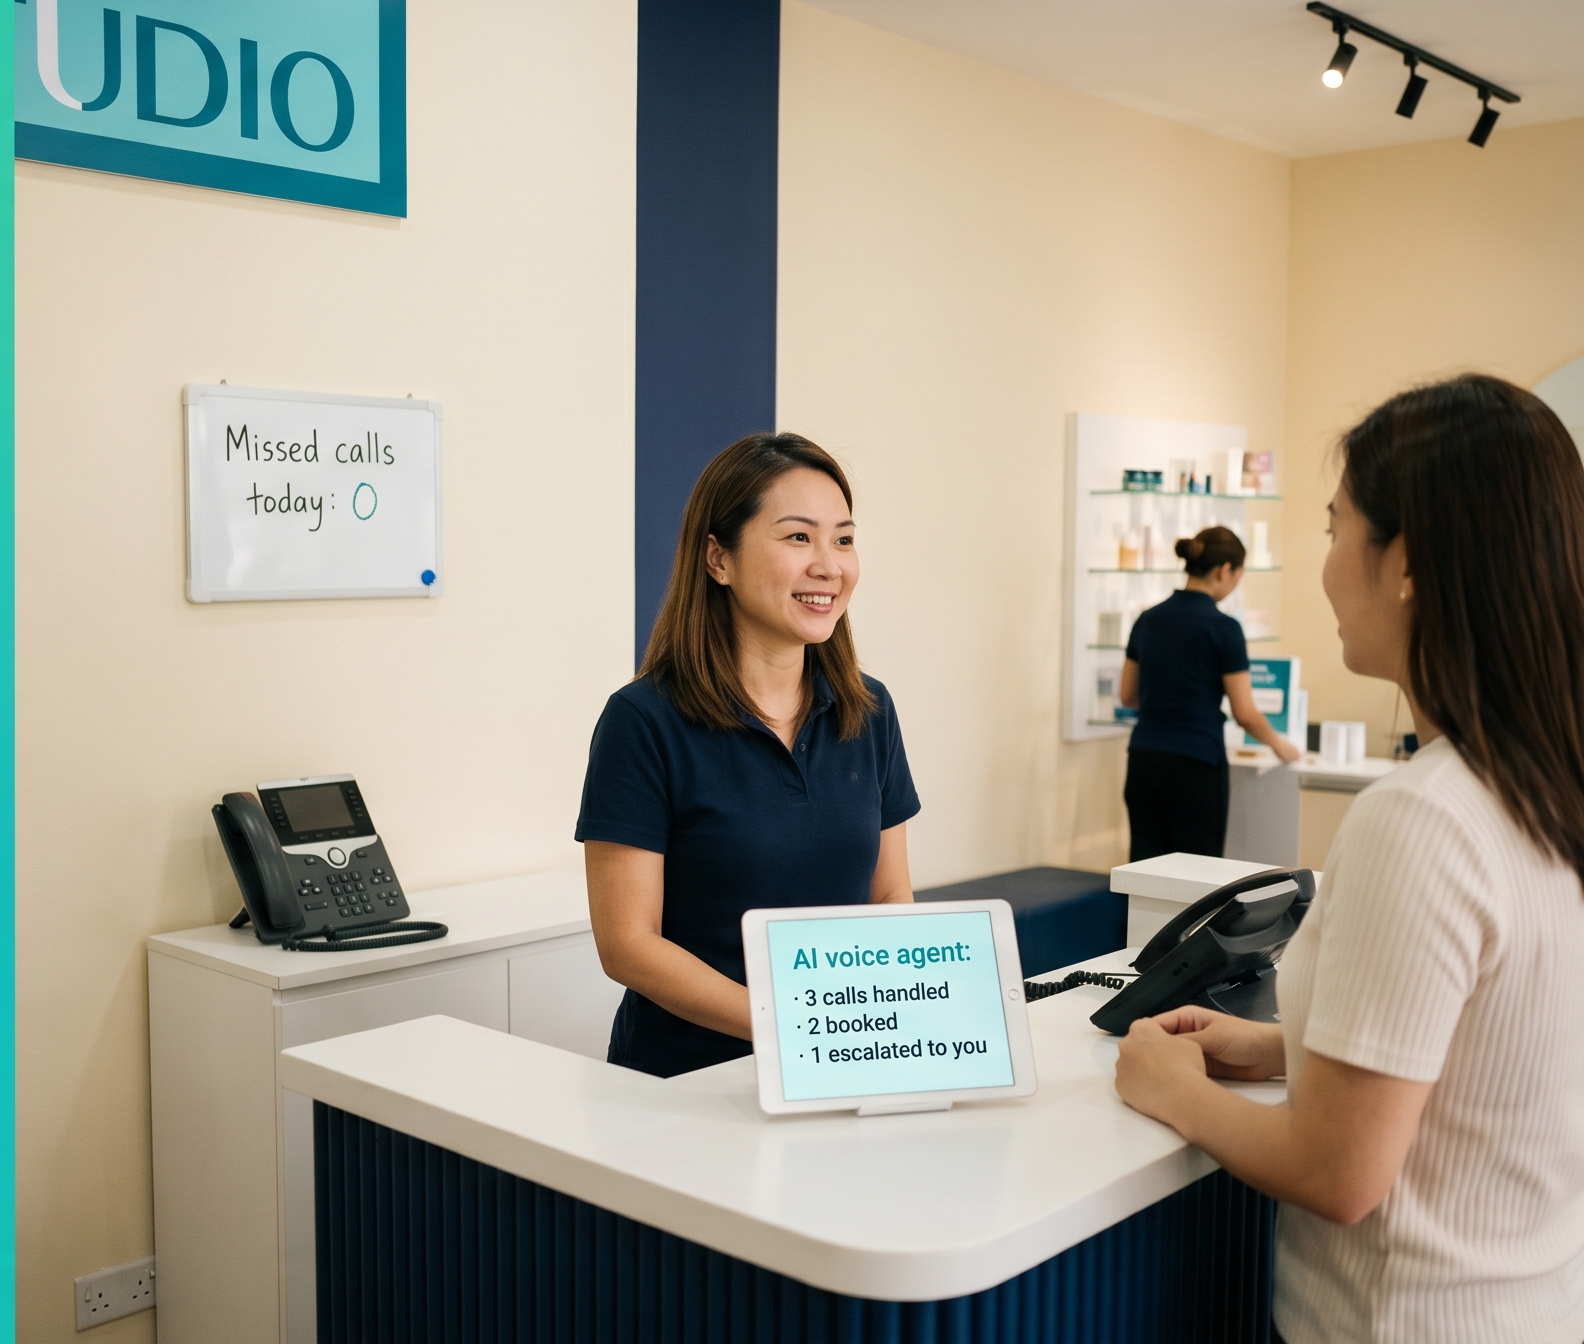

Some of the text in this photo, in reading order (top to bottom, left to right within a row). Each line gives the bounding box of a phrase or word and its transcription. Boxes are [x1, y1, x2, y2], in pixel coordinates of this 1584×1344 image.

[14, 0, 355, 153] UDIO
[226, 424, 395, 466] Missed calls
[246, 481, 378, 533] today: 0
[792, 941, 971, 970] AI voice agent:
[804, 980, 950, 1007] 3 calls handled
[807, 1011, 898, 1035] 2 booked
[810, 1038, 988, 1064] 1 escalated to you
